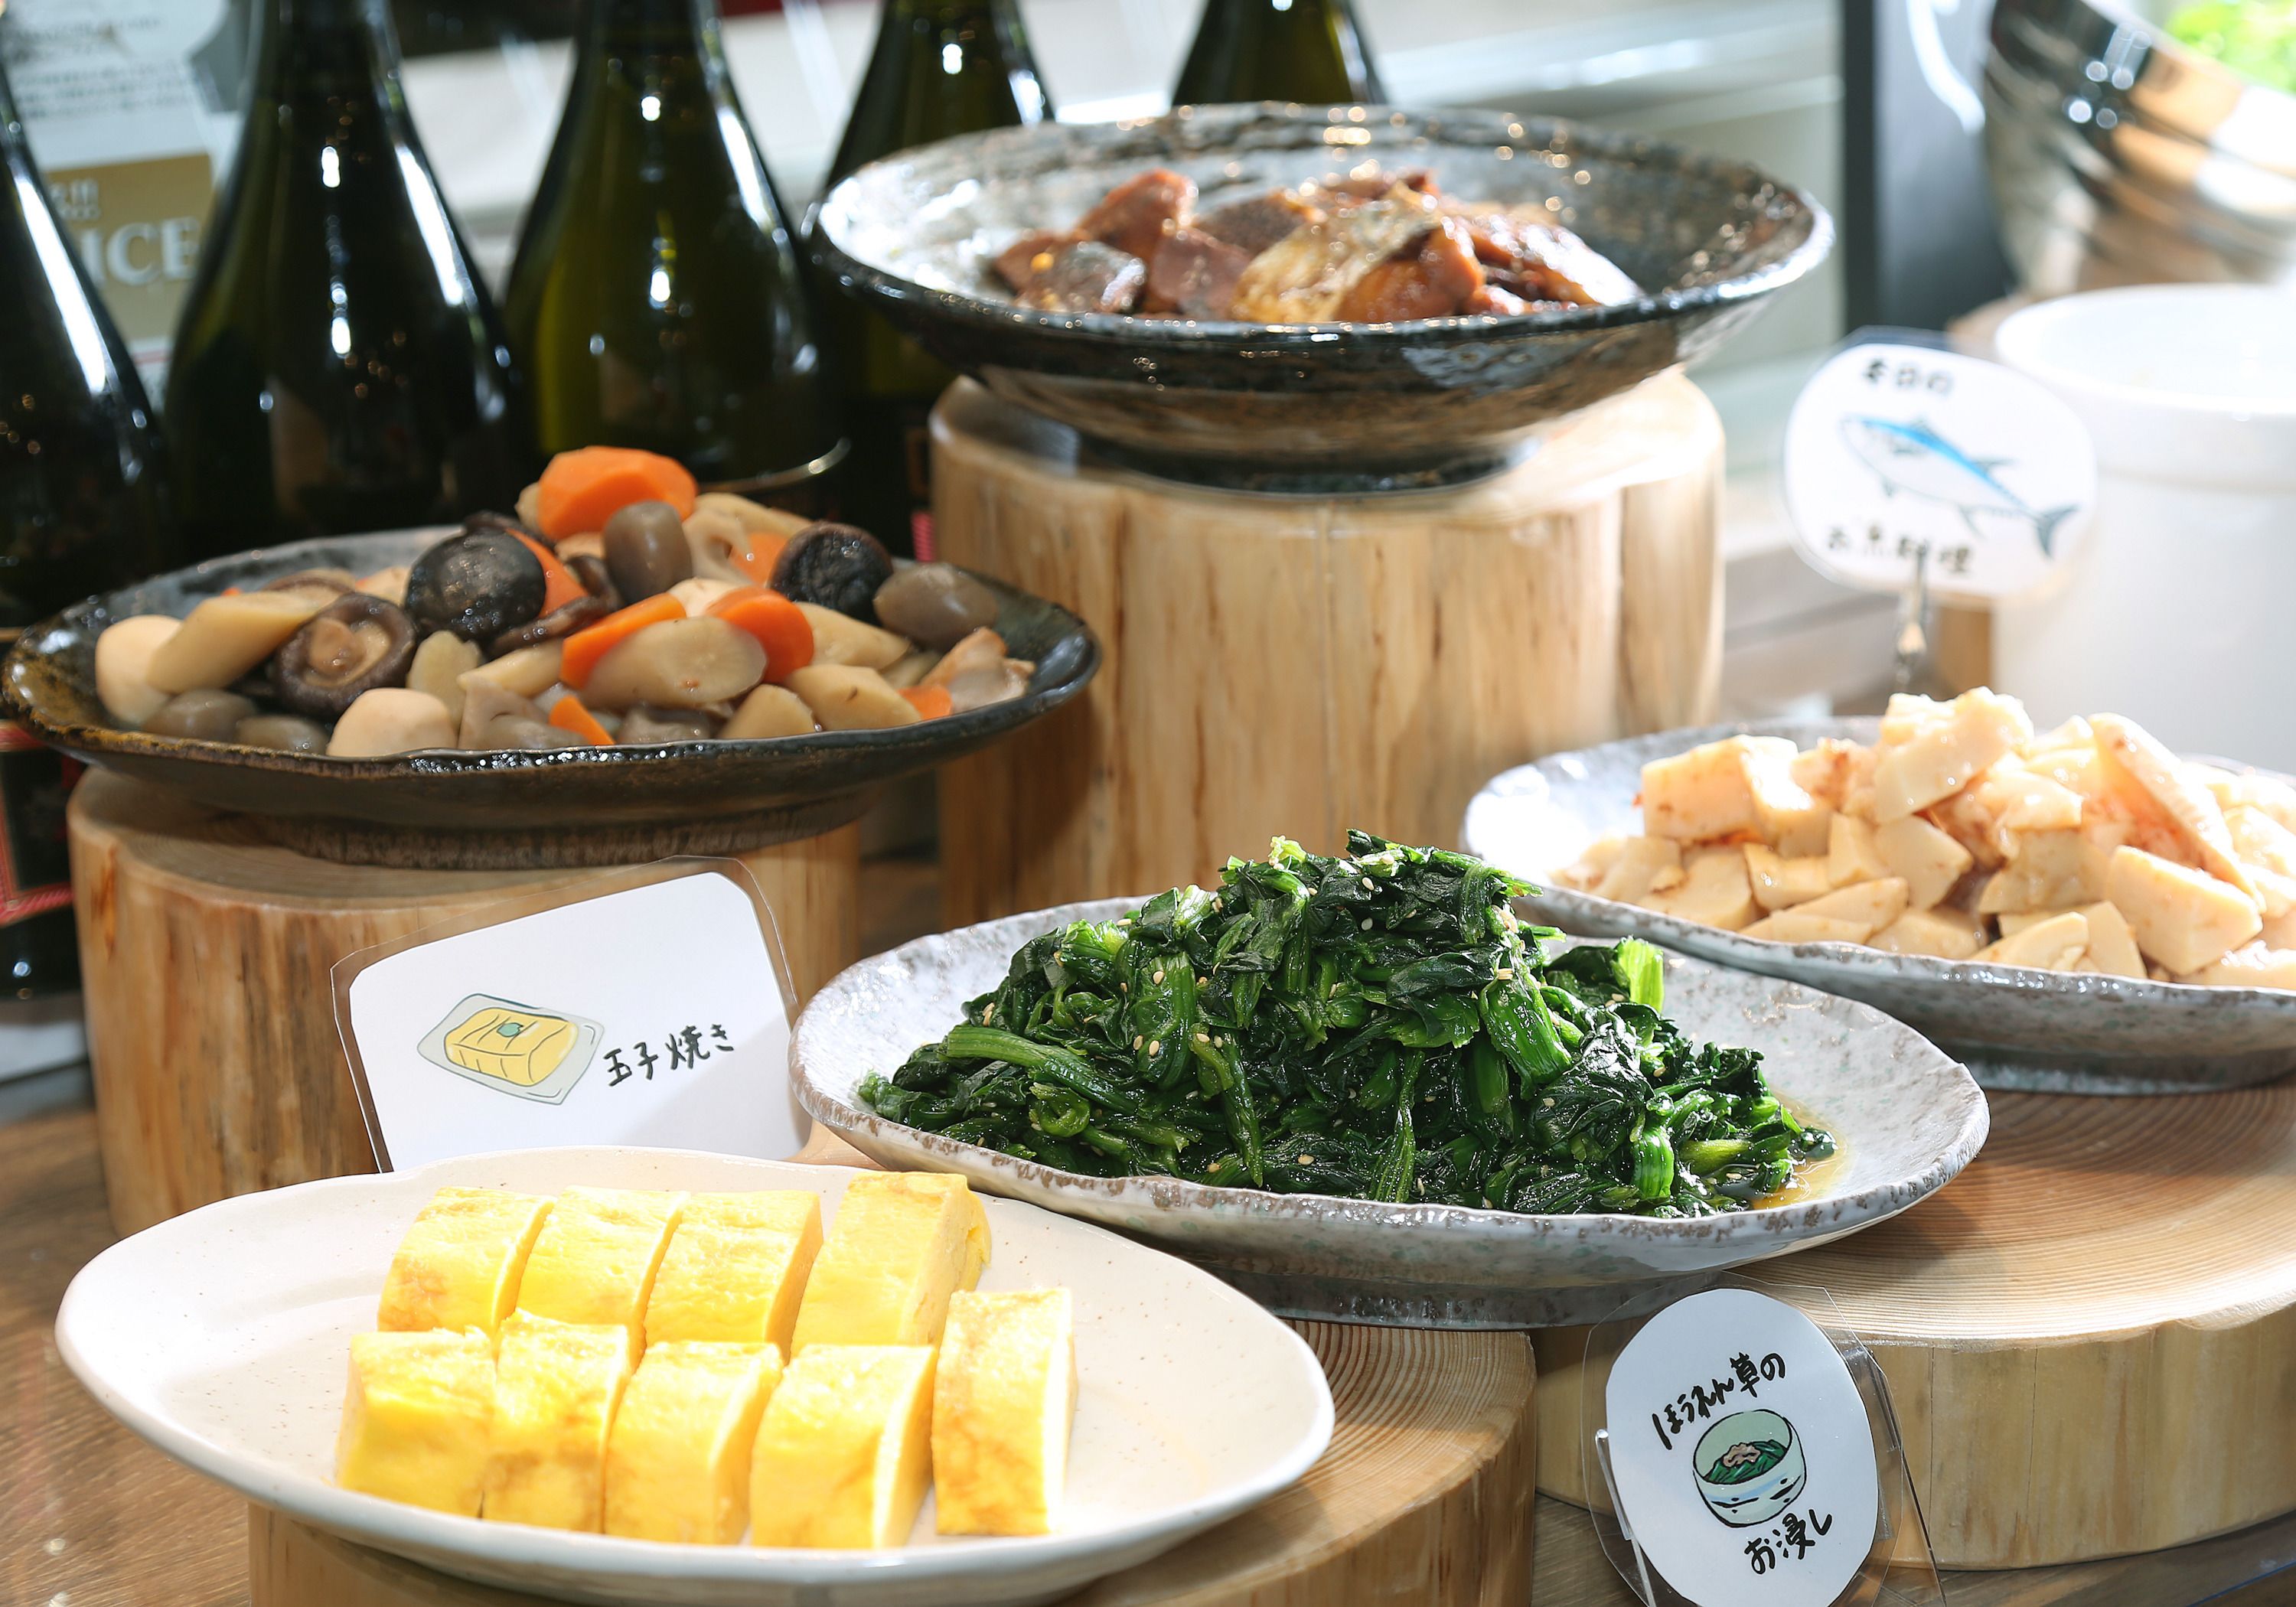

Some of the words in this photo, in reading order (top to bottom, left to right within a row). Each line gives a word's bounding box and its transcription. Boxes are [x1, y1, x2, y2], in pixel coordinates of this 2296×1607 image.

[602, 1024, 735, 1087] 玉子焼き
[1652, 1351, 1786, 1450] ほうれん草の
[1743, 1508, 1833, 1575] お浸し
